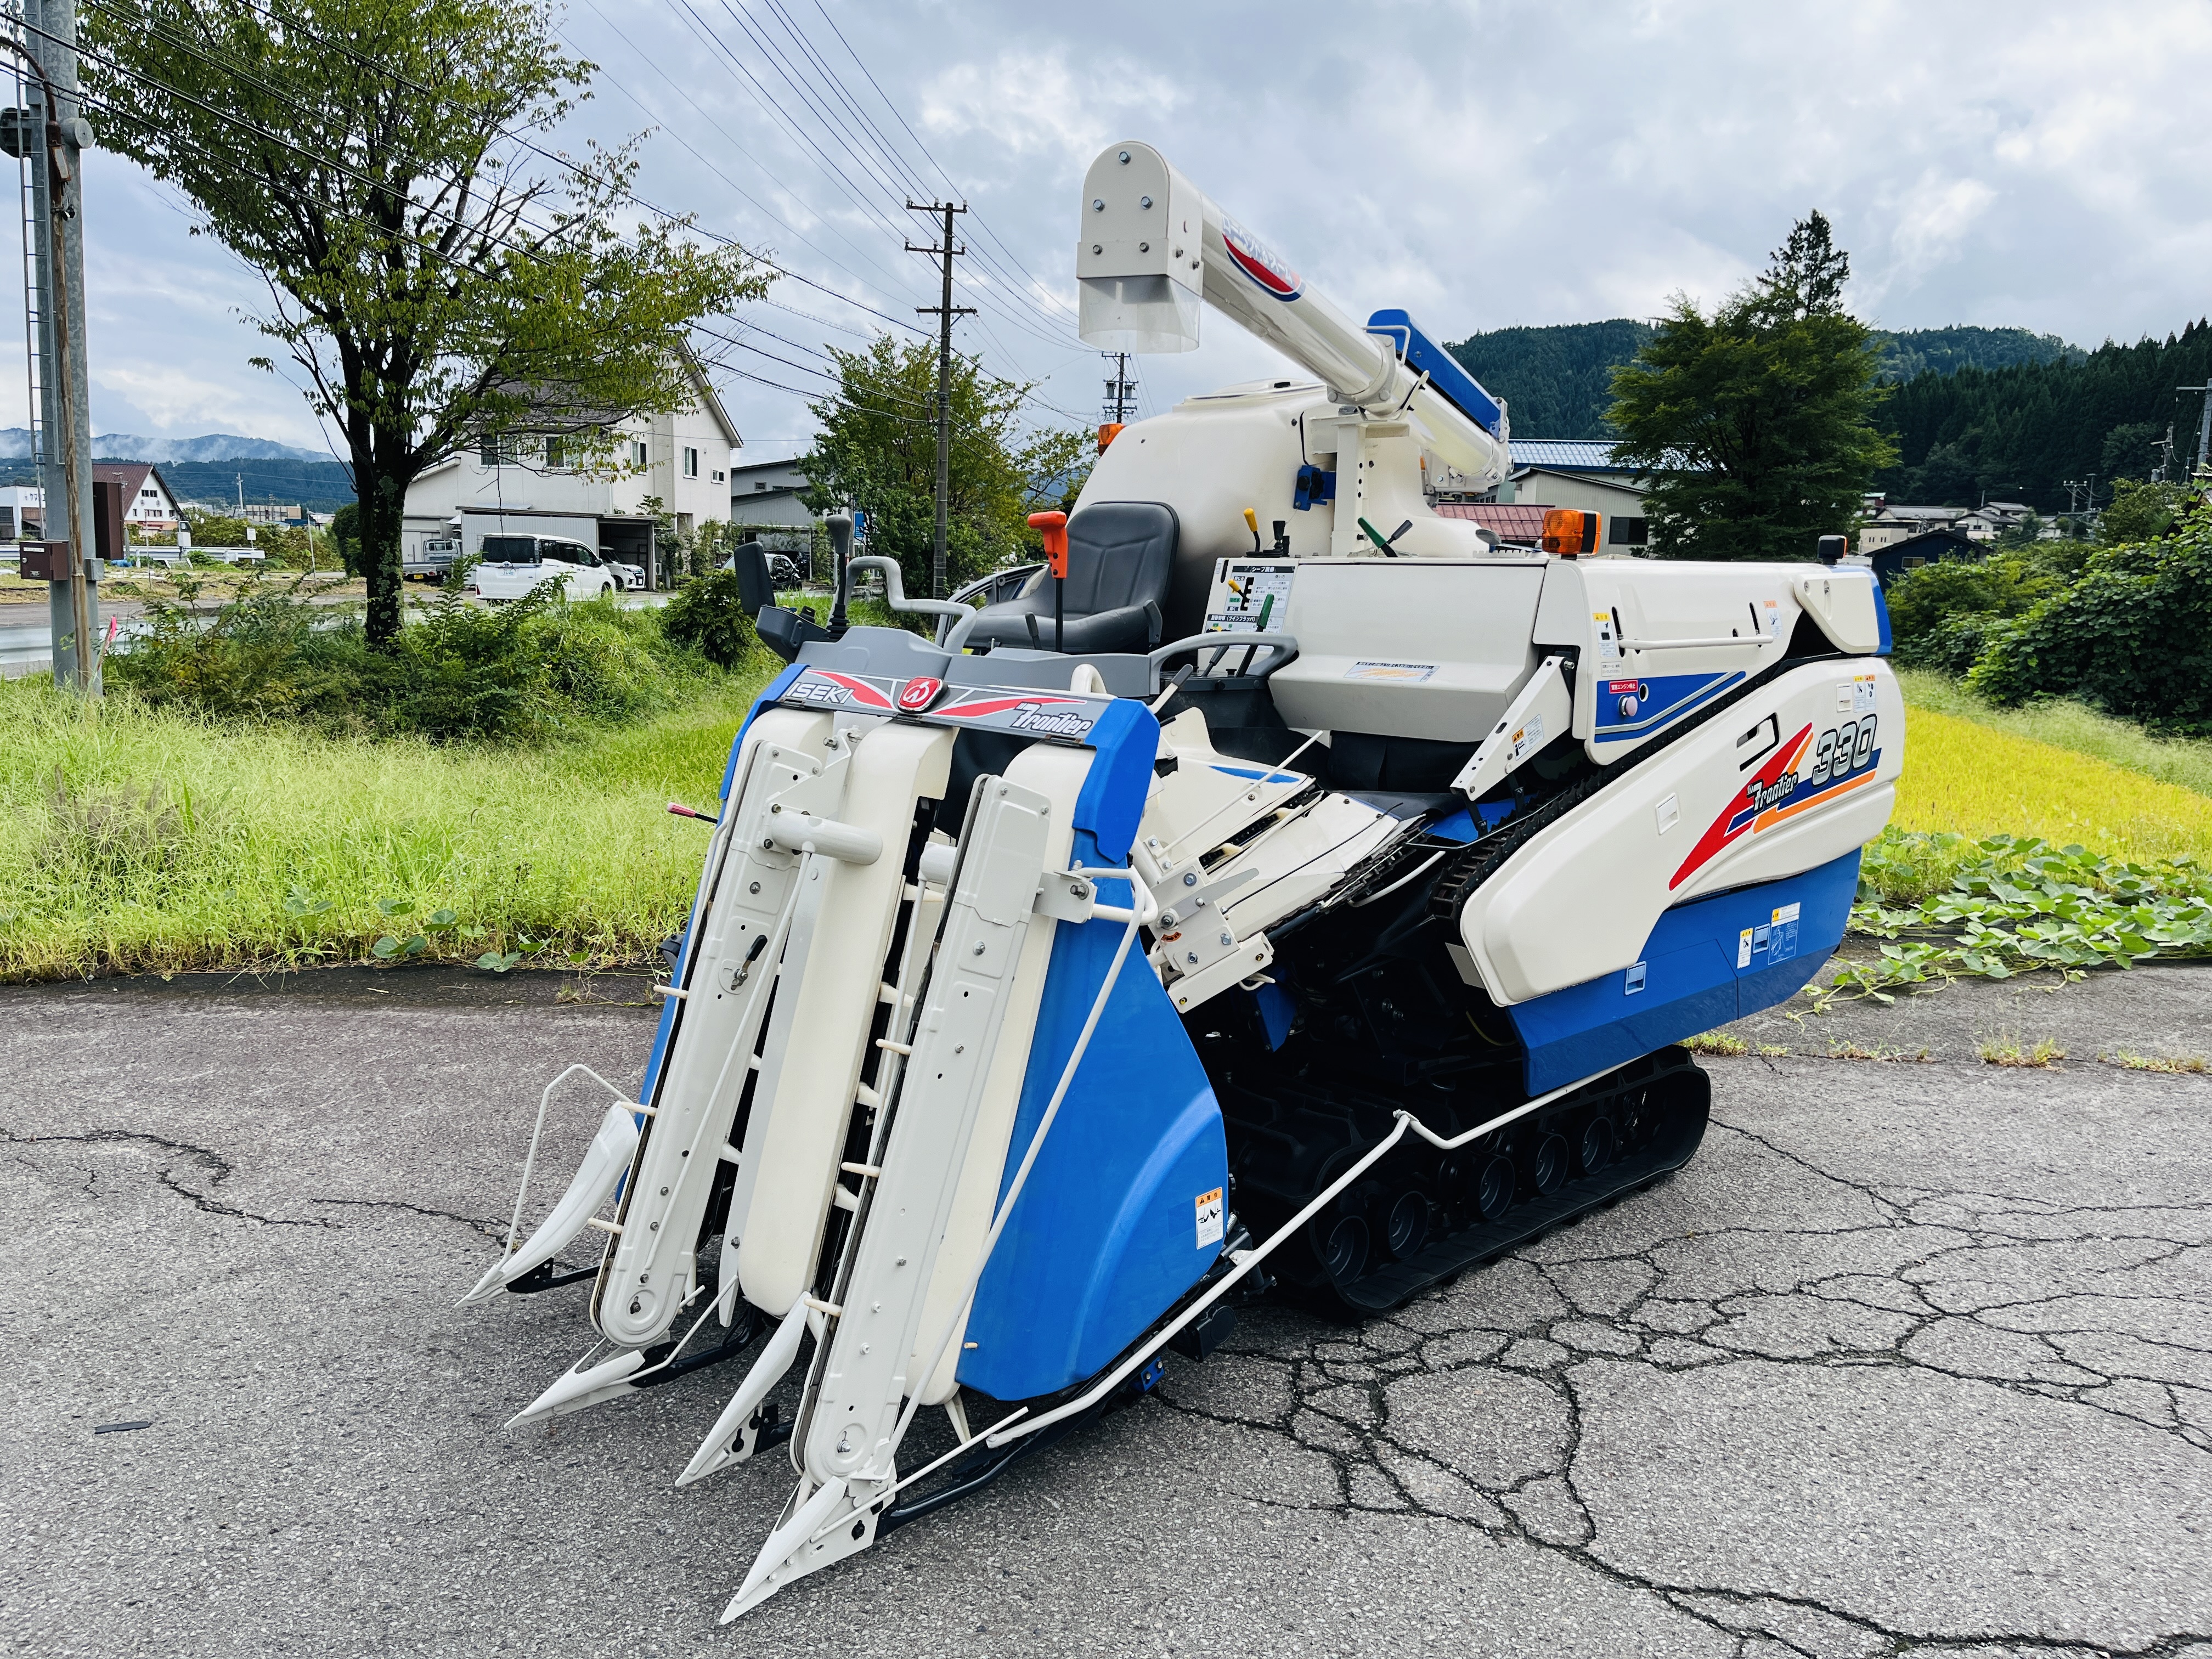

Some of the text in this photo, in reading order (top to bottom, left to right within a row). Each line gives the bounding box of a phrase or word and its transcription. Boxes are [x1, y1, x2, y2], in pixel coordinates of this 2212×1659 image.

[785, 682, 855, 704] ISEKI
[1010, 701, 1093, 736] Frontier
[1812, 713, 1877, 788] 330
[1747, 771, 1798, 813] Frontier
